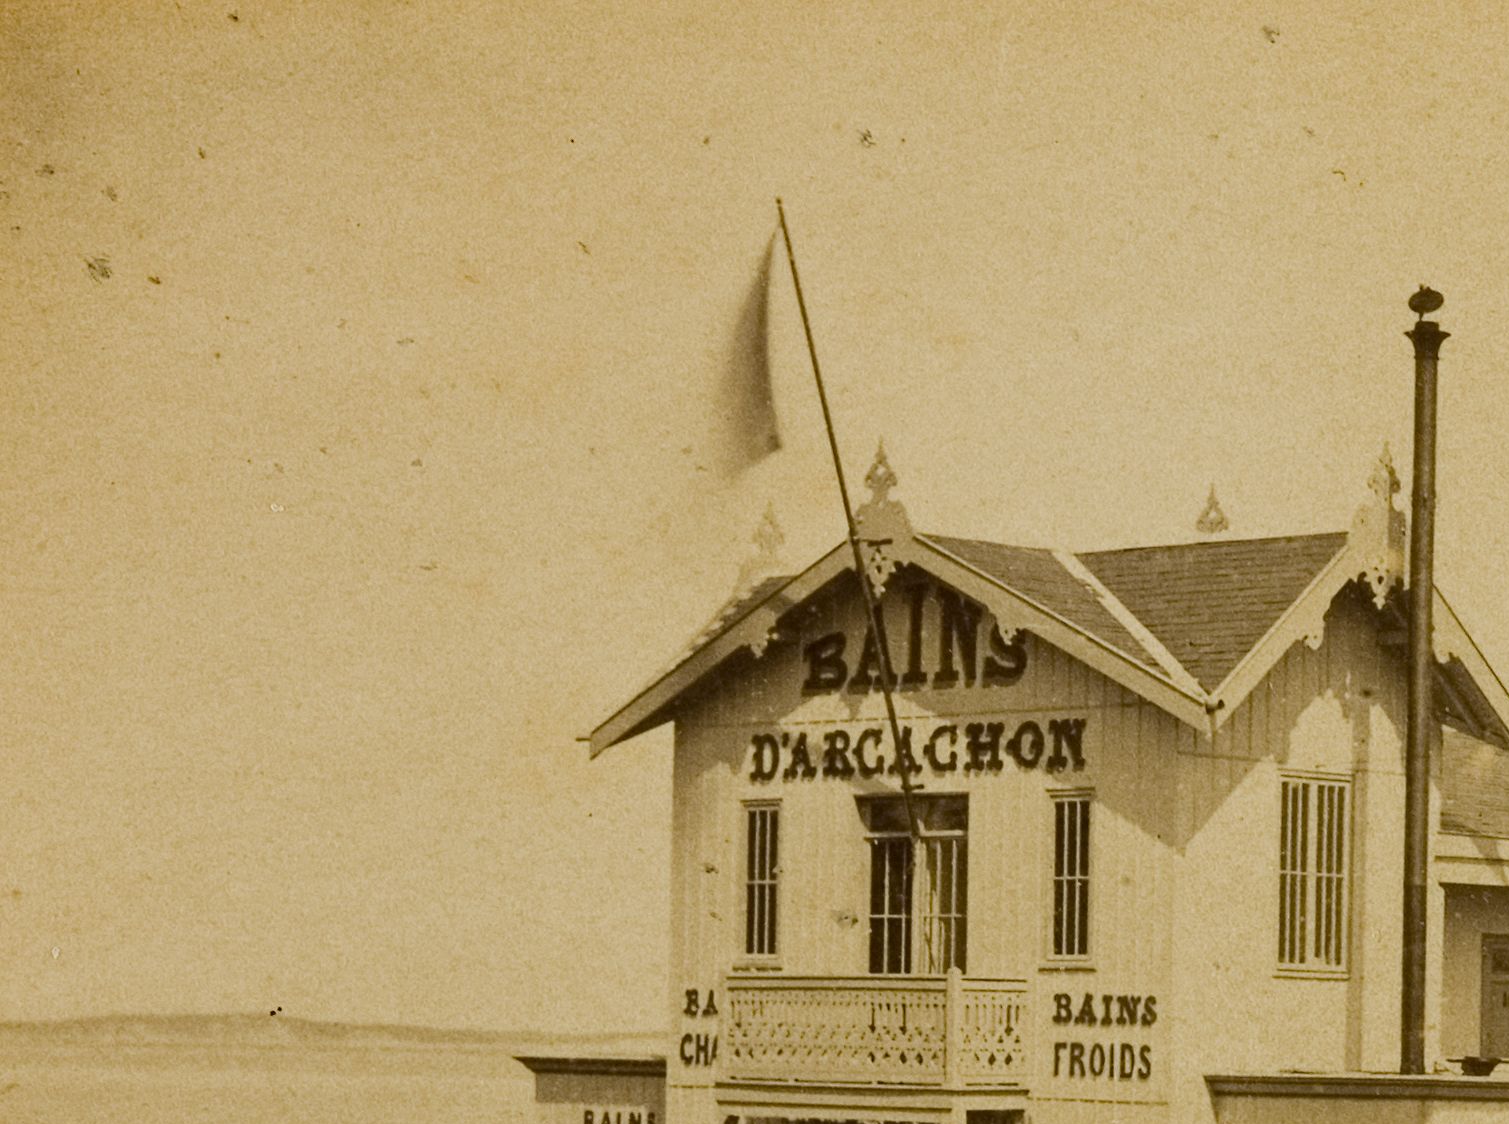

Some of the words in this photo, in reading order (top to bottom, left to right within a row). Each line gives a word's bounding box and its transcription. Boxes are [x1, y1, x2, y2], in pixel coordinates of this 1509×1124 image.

[802, 582, 1028, 694] BAINS
[750, 718, 1087, 782] D'ARCACHON
[1052, 992, 1158, 1027] BAINS
[1053, 1041, 1152, 1079] FROIDS
